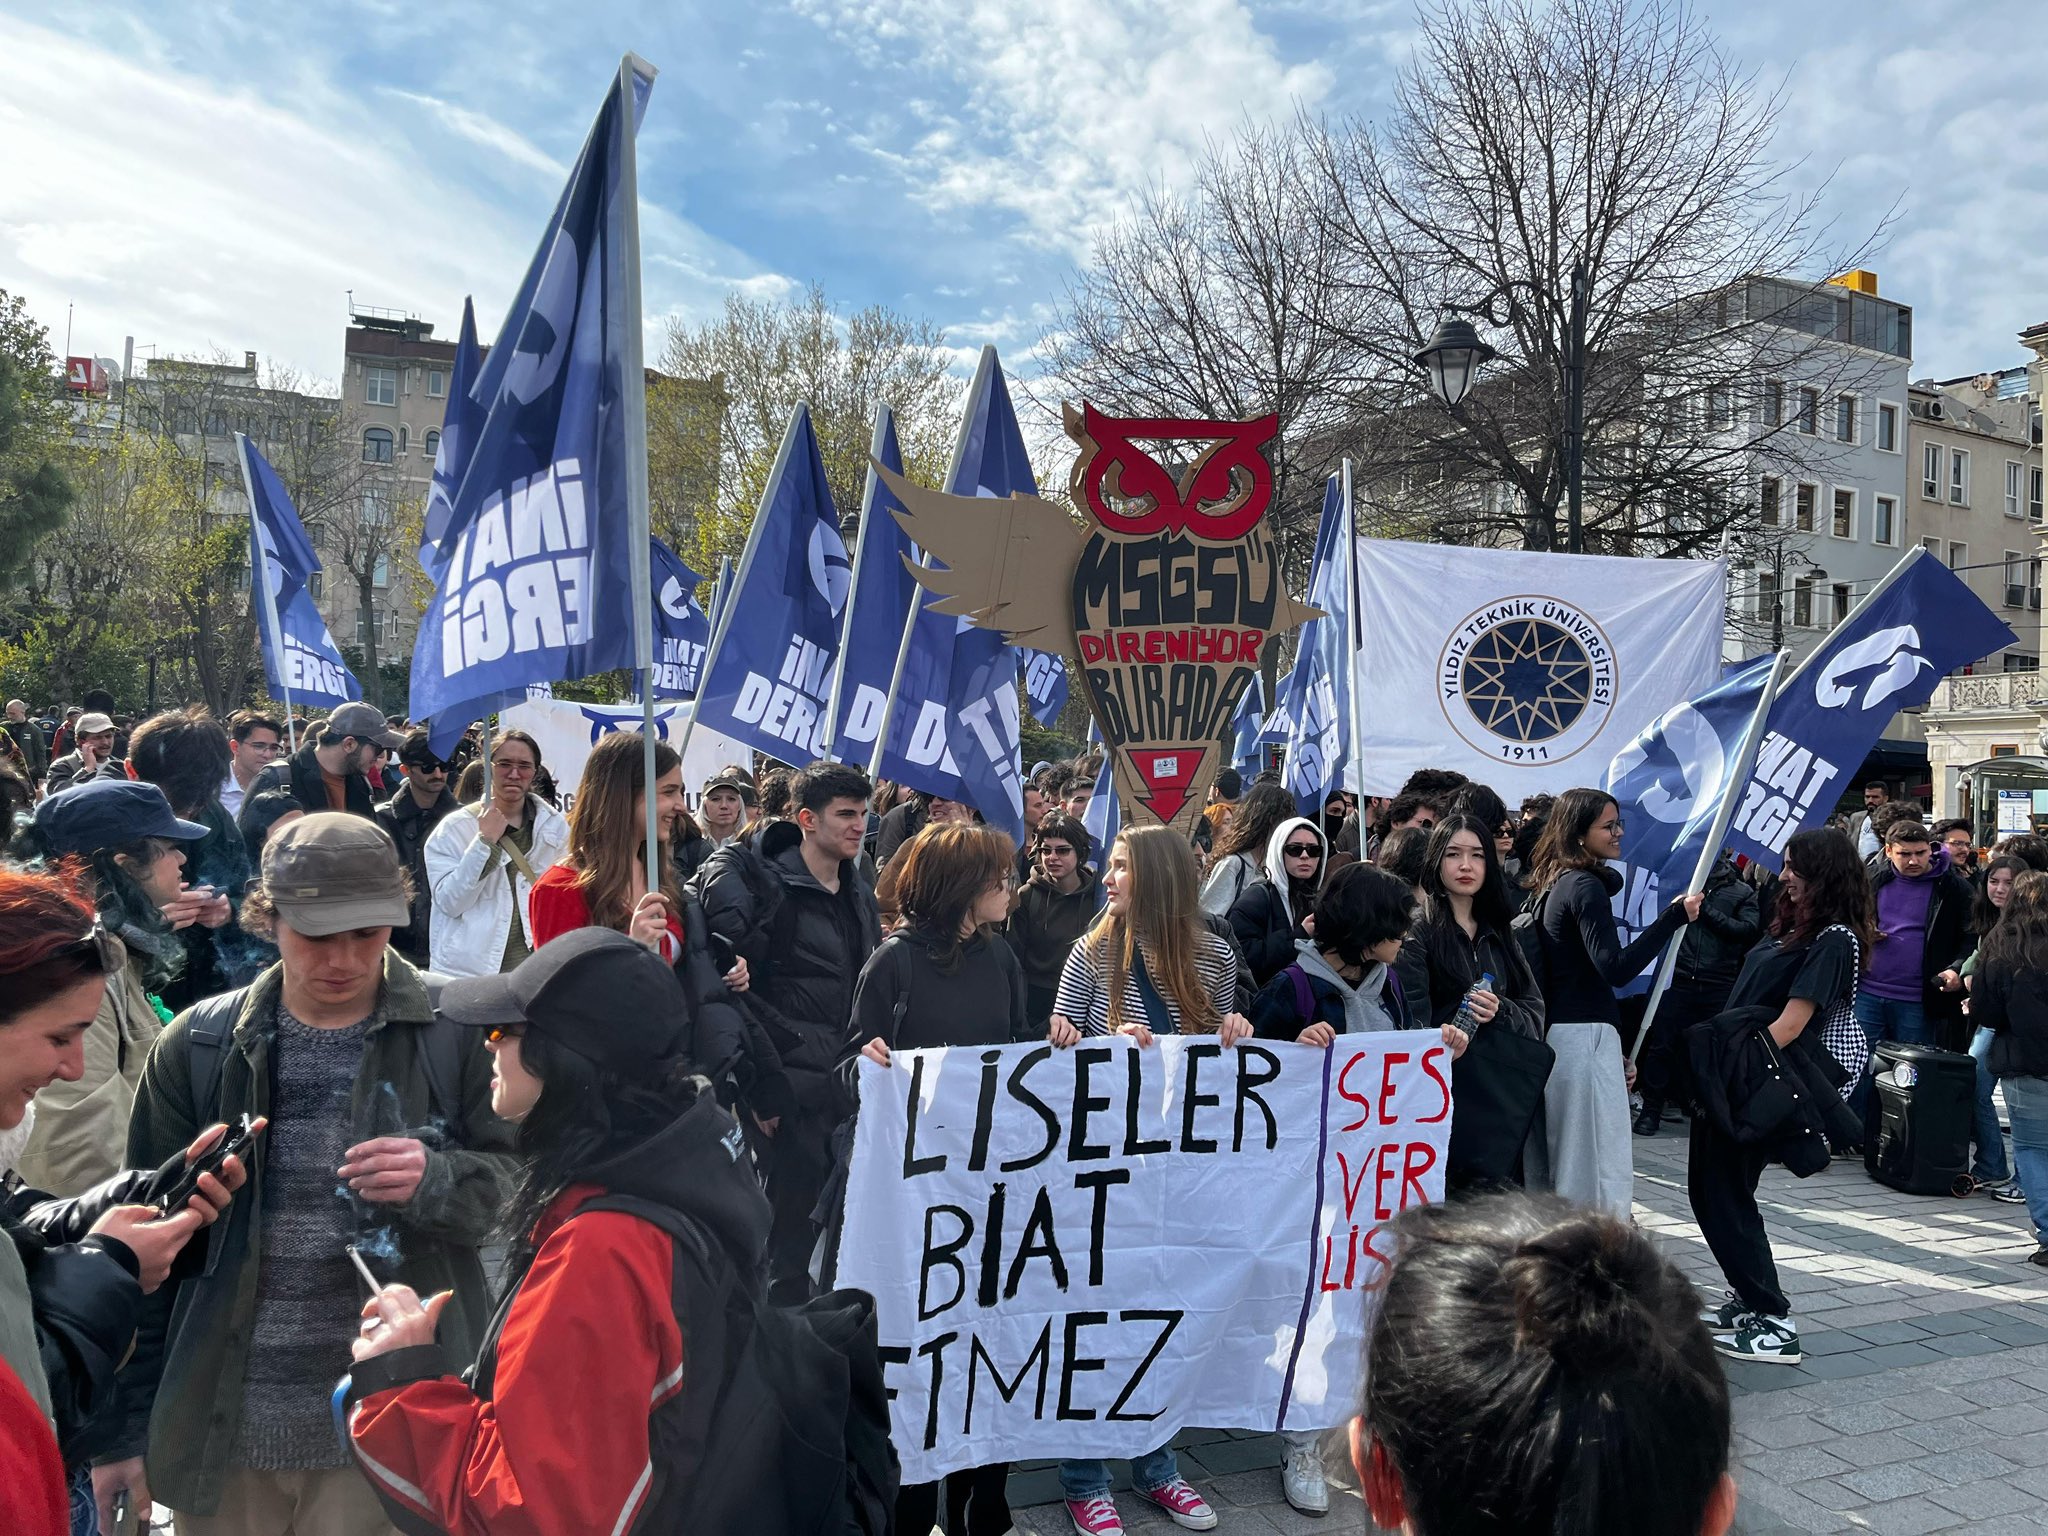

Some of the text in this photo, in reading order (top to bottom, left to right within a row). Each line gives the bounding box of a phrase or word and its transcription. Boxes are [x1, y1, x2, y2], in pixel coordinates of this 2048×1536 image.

[1073, 529, 1278, 630] MSGSÜ
[282, 648, 350, 701] ERGİ
[1079, 626, 1264, 665] DİRENİYOR
[1445, 600, 1612, 706] YILDIZ TEKNİK ÜNİVERSİTESİ
[1086, 663, 1255, 746] BURADA
[1502, 745, 1549, 760] 1911
[903, 1044, 1282, 1179] LİSELER
[1338, 1047, 1450, 1132] SES
[1337, 1142, 1437, 1224] VER
[1320, 1224, 1393, 1294] LİS
